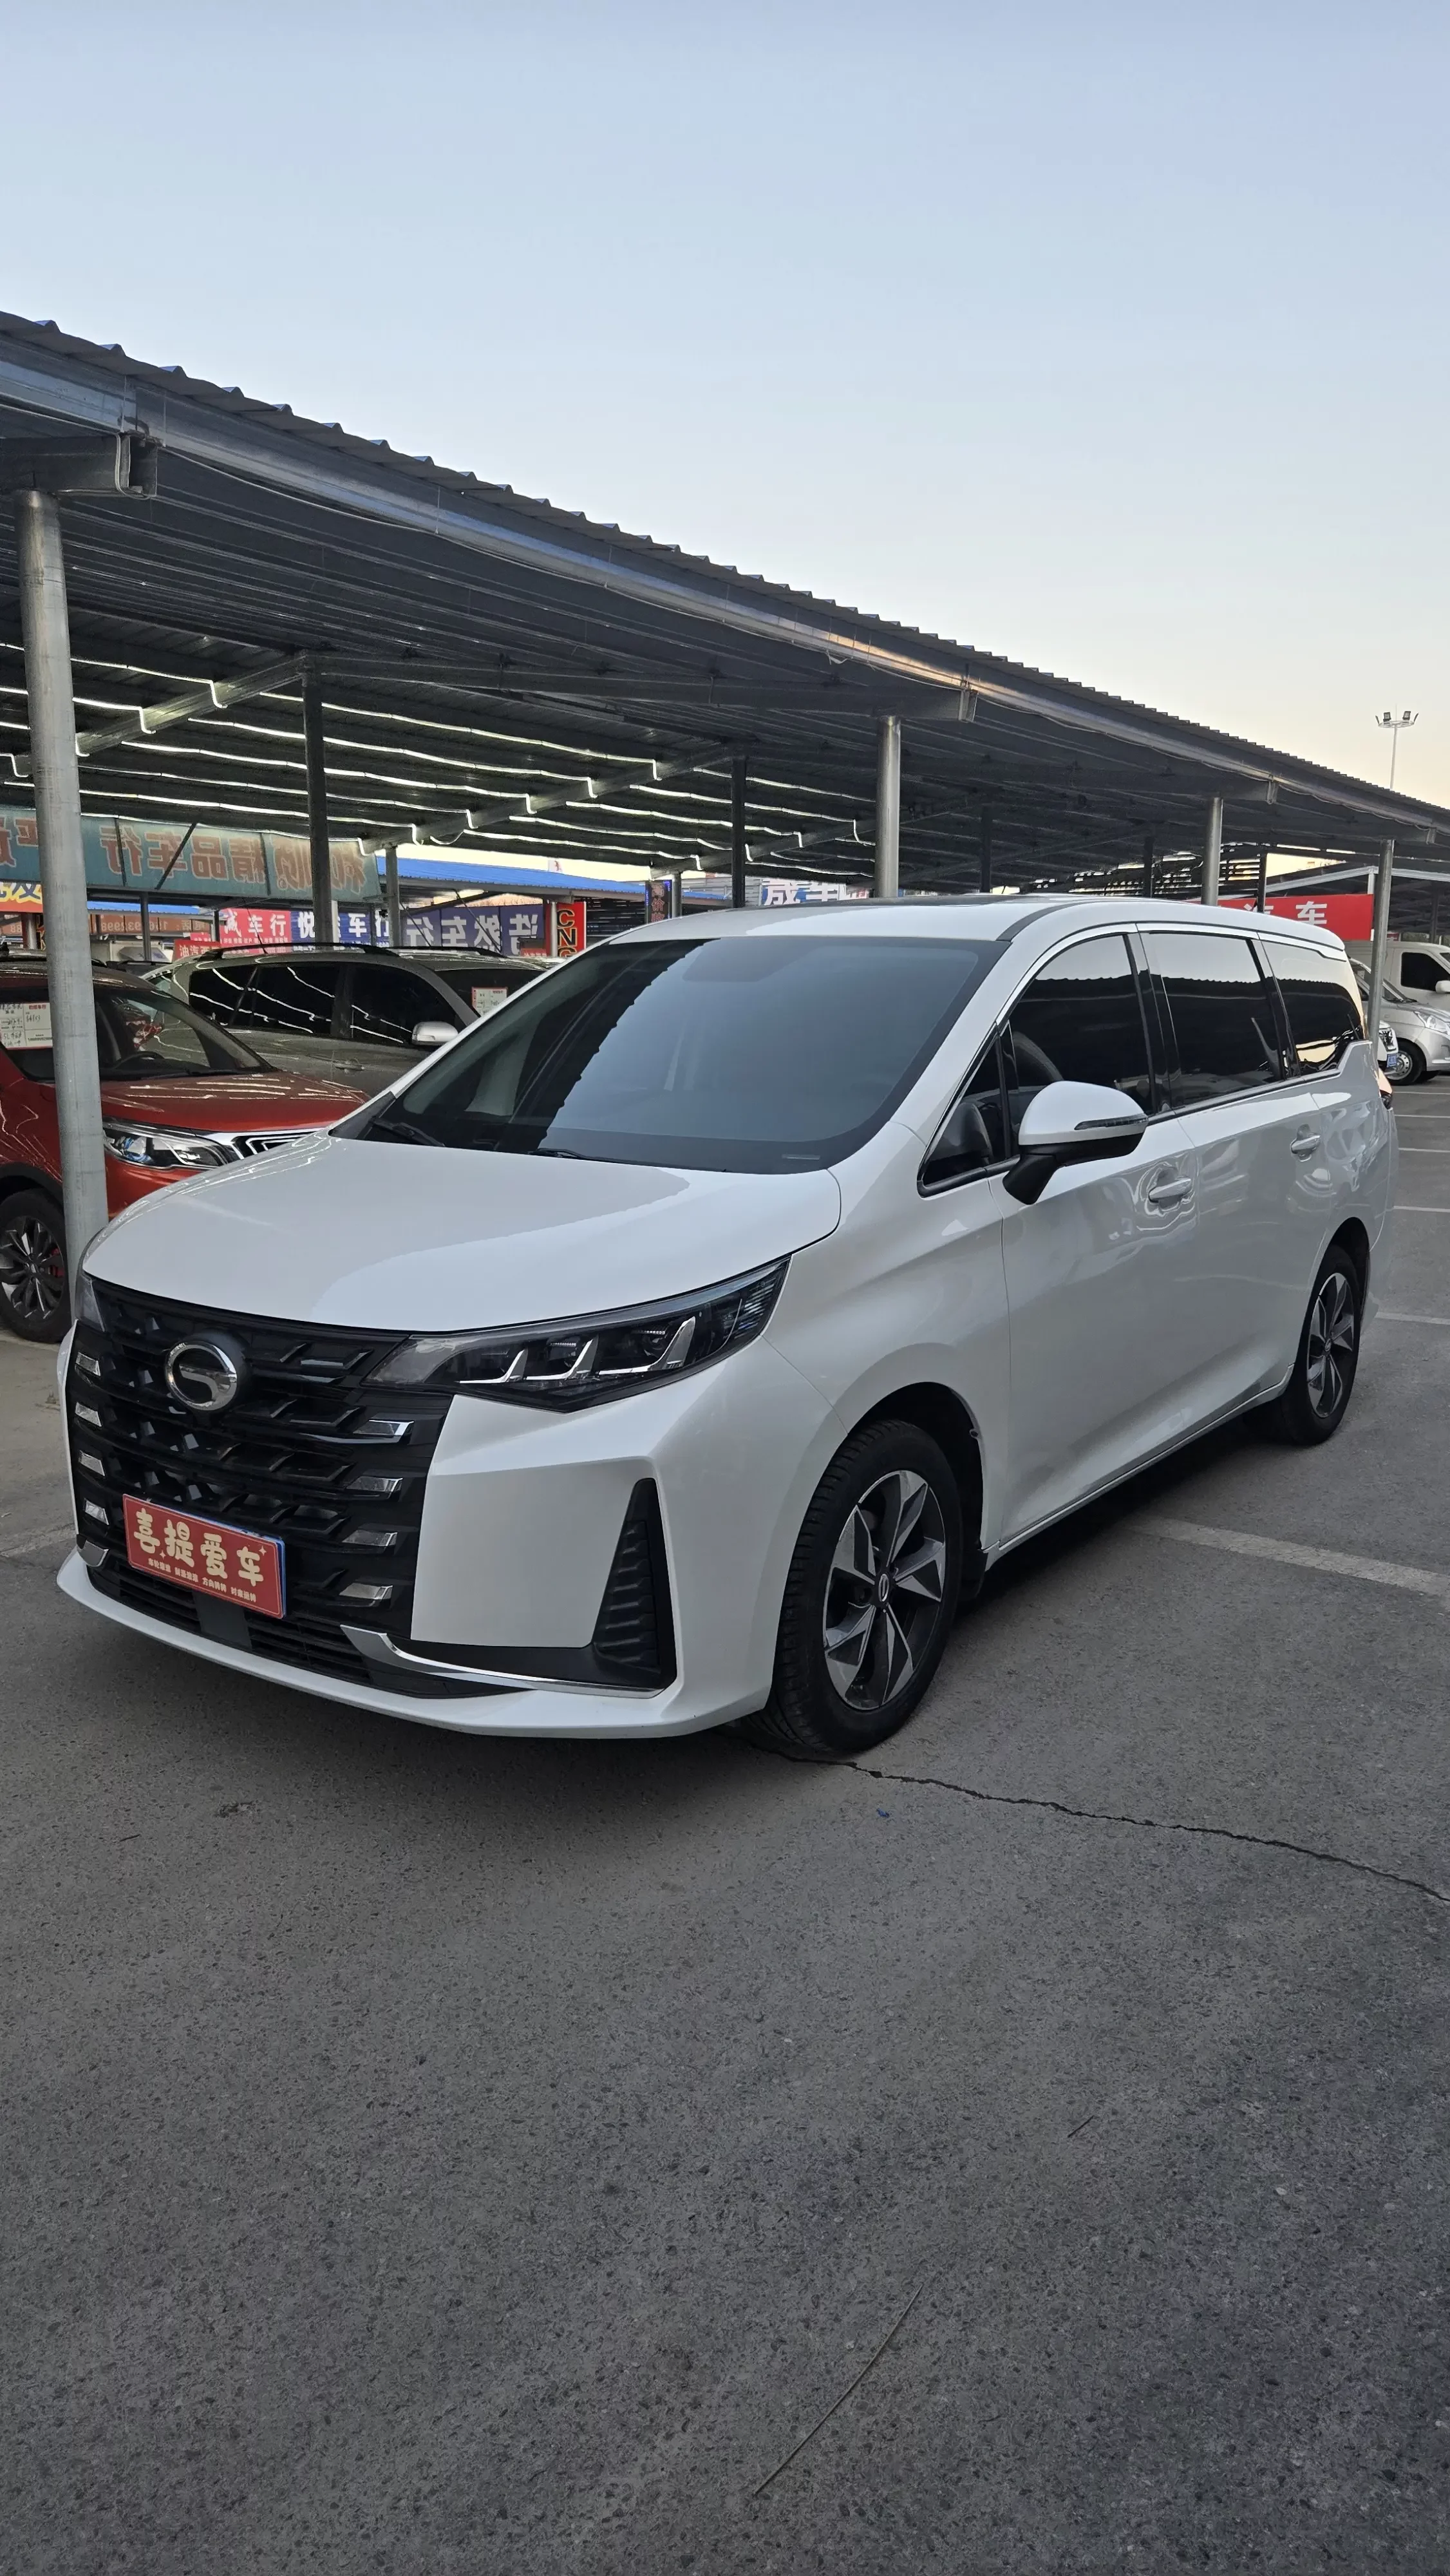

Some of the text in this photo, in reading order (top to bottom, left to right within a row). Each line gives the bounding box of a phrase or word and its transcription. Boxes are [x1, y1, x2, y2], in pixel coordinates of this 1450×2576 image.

[298, 910, 390, 938] 悦车行
[133, 1508, 264, 1587] 喜提爱车
